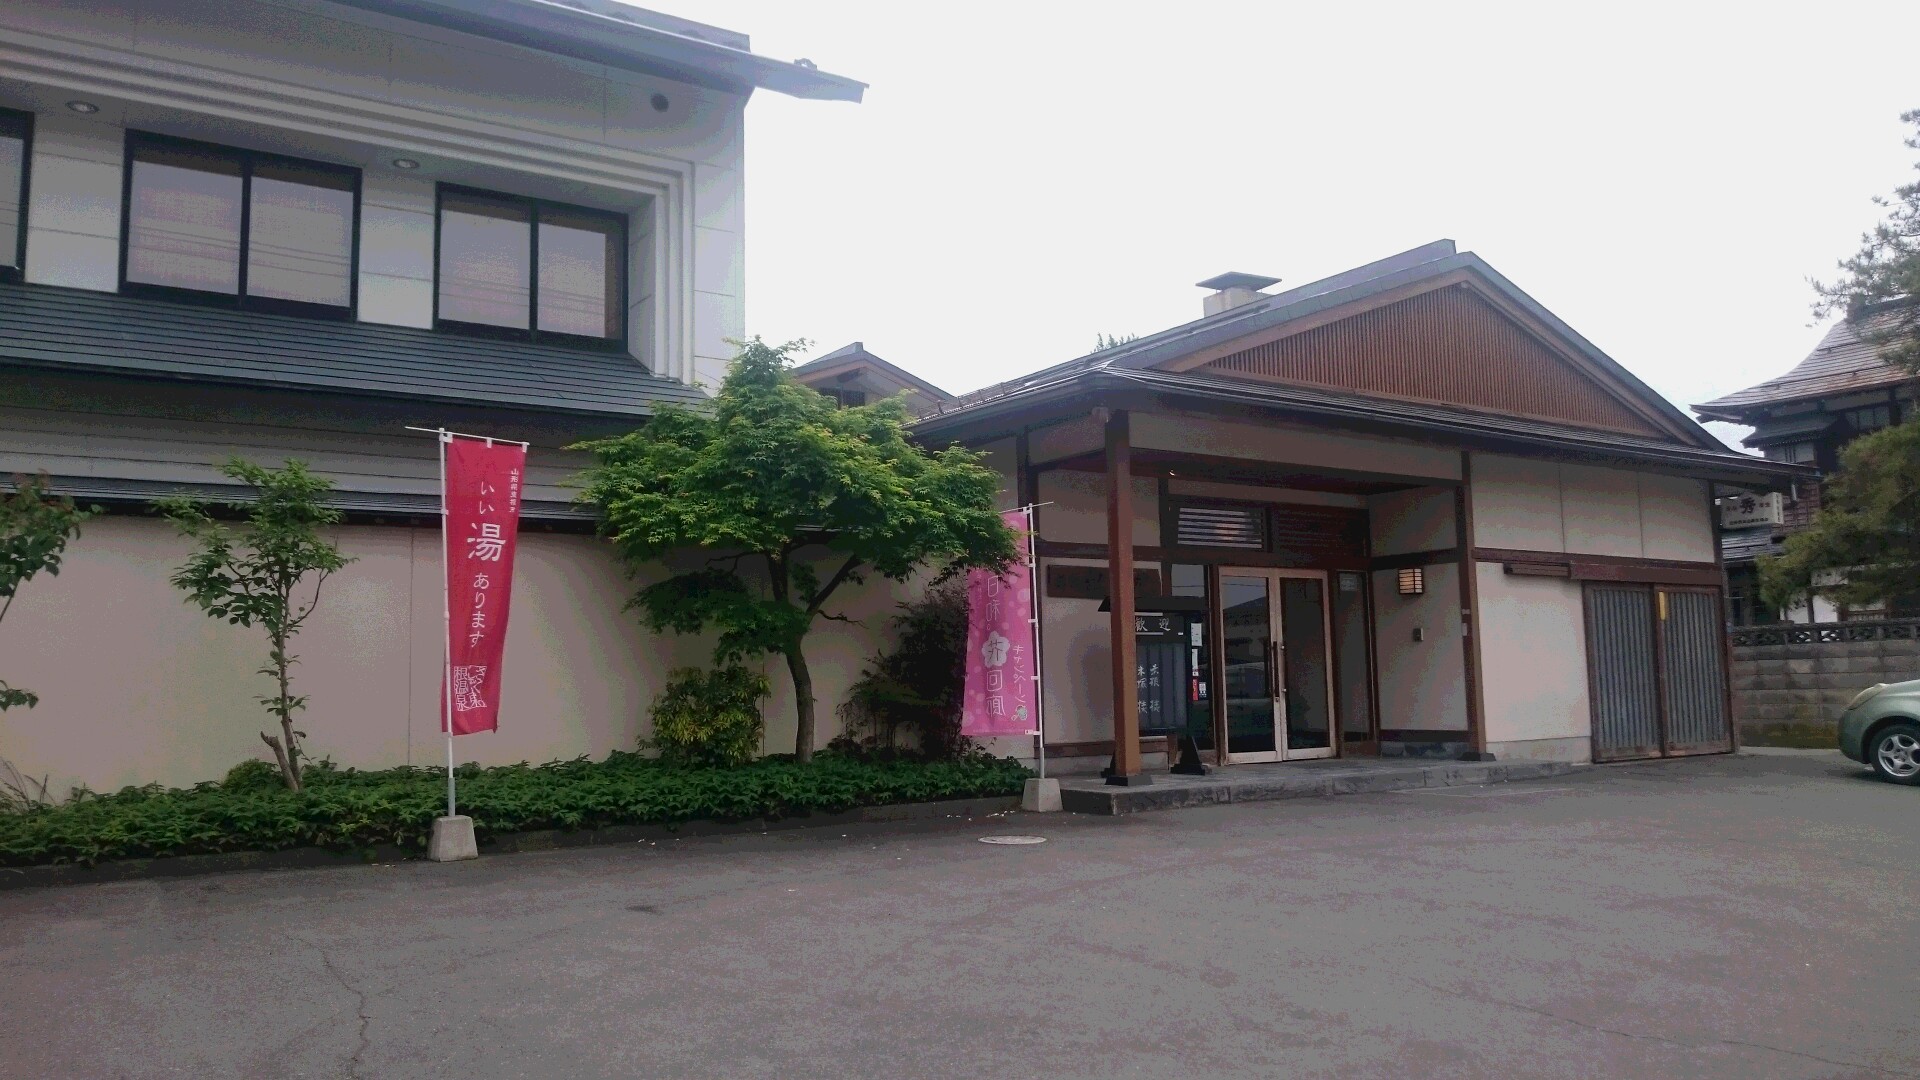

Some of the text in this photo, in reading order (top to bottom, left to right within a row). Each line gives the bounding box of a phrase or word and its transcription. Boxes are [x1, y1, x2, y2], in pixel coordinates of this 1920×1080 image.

[467, 481, 506, 648] いい湯あります
[1135, 617, 1171, 632] 歓迎
[1013, 644, 1026, 704] キャンペーン
